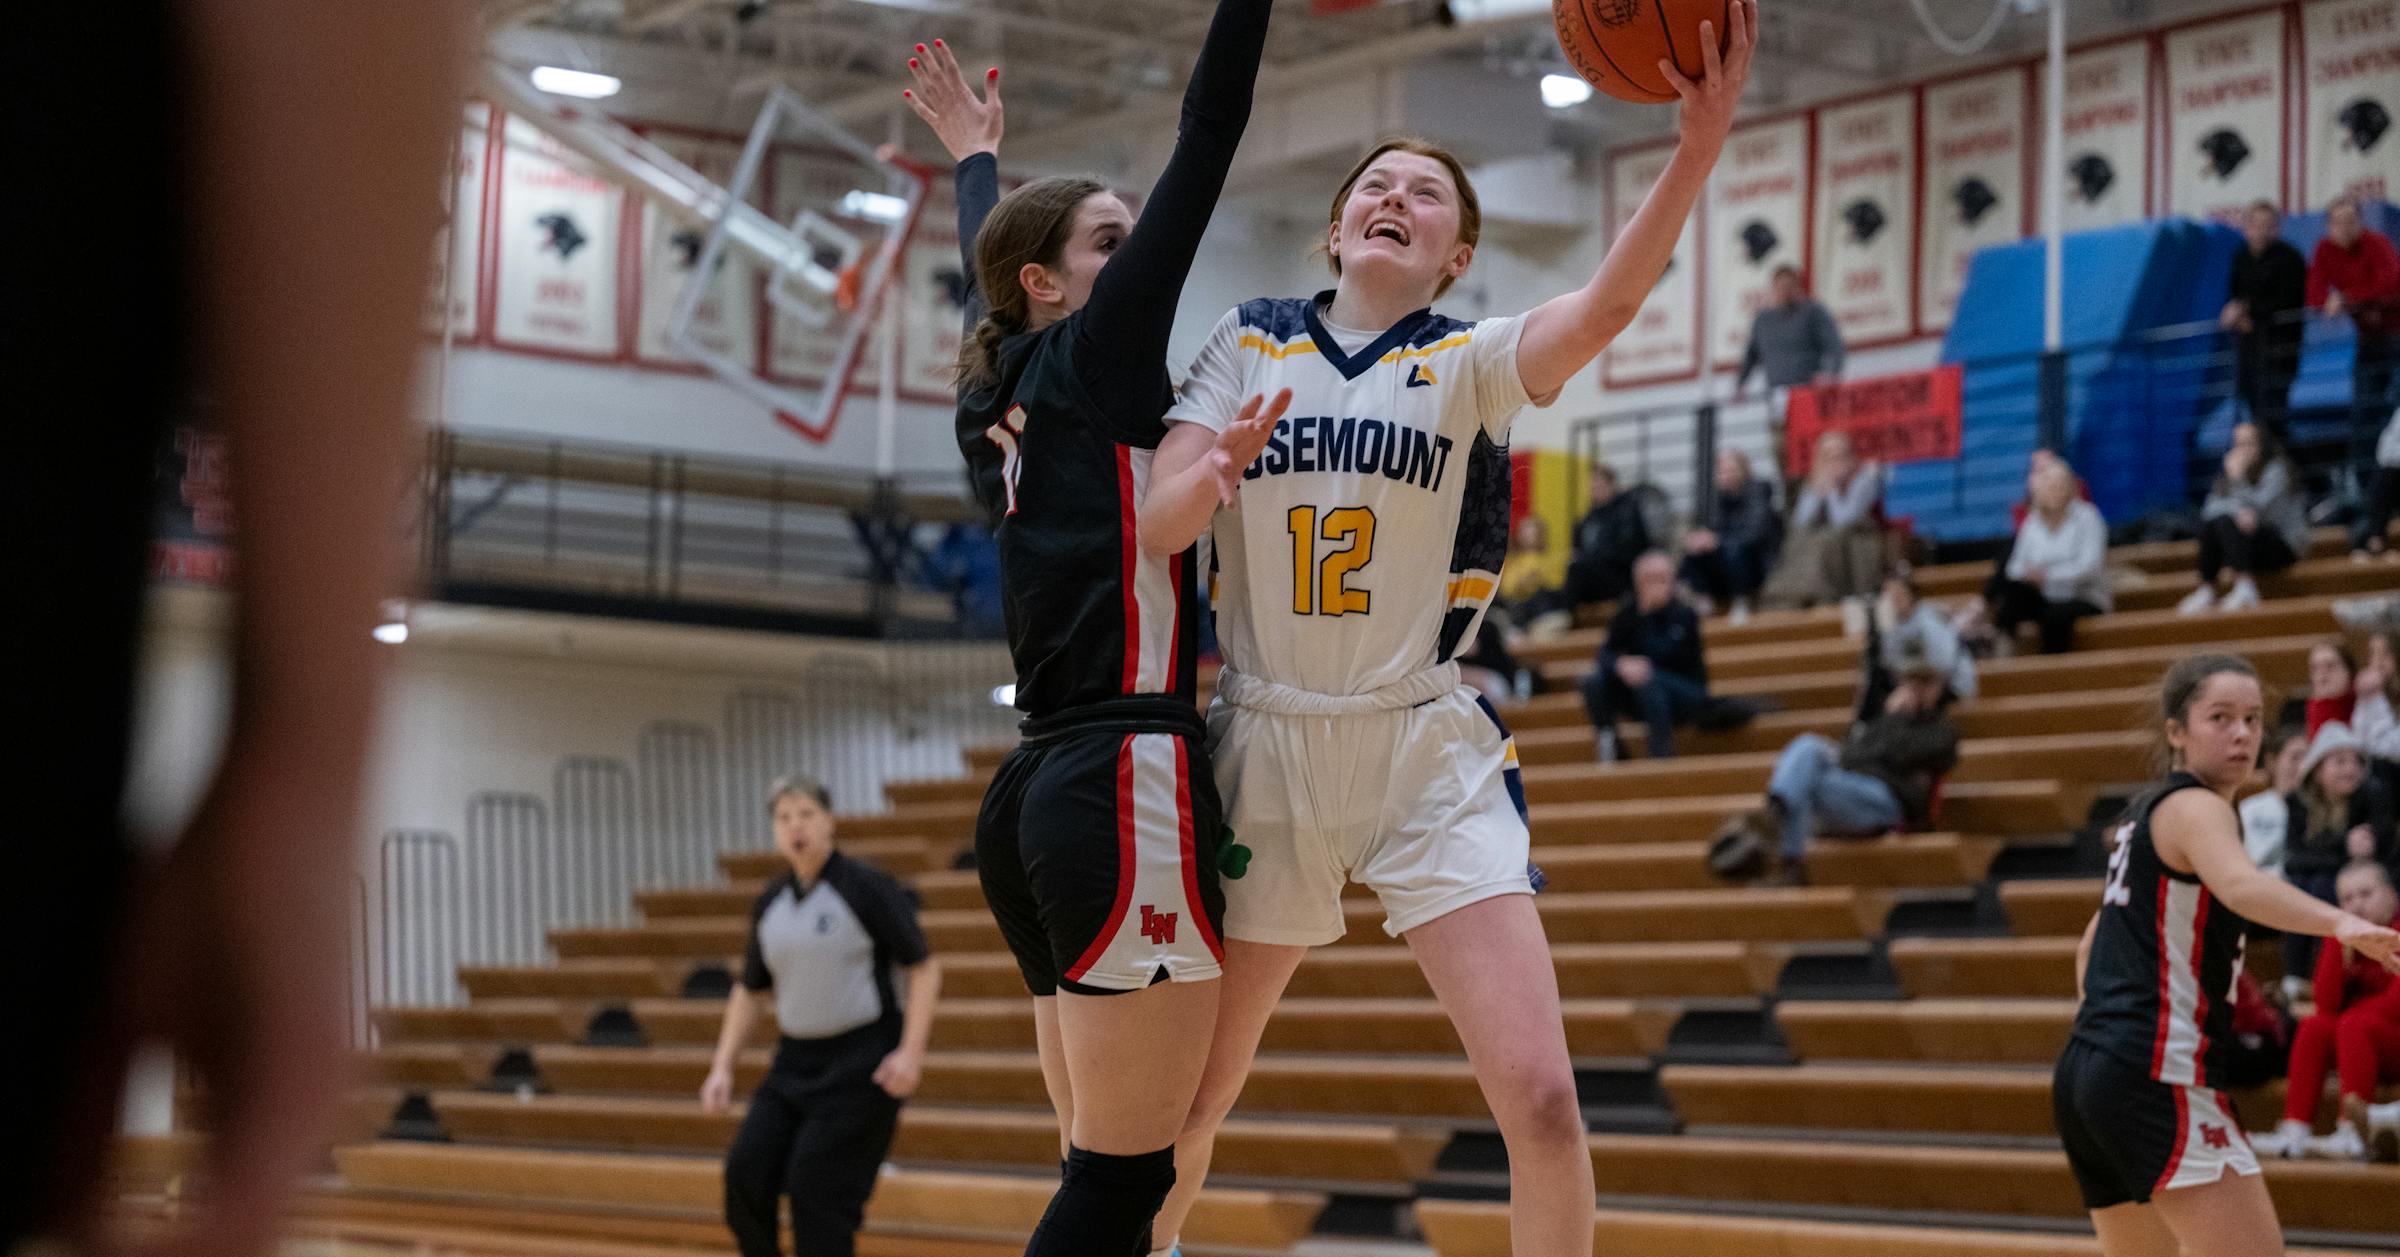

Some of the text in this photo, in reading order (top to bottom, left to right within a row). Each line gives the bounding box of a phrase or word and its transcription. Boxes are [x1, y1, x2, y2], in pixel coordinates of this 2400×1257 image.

[1236, 416, 1453, 492] SEMOUNT
[1287, 505, 1377, 616] 12
[1140, 904, 1178, 945] LN
